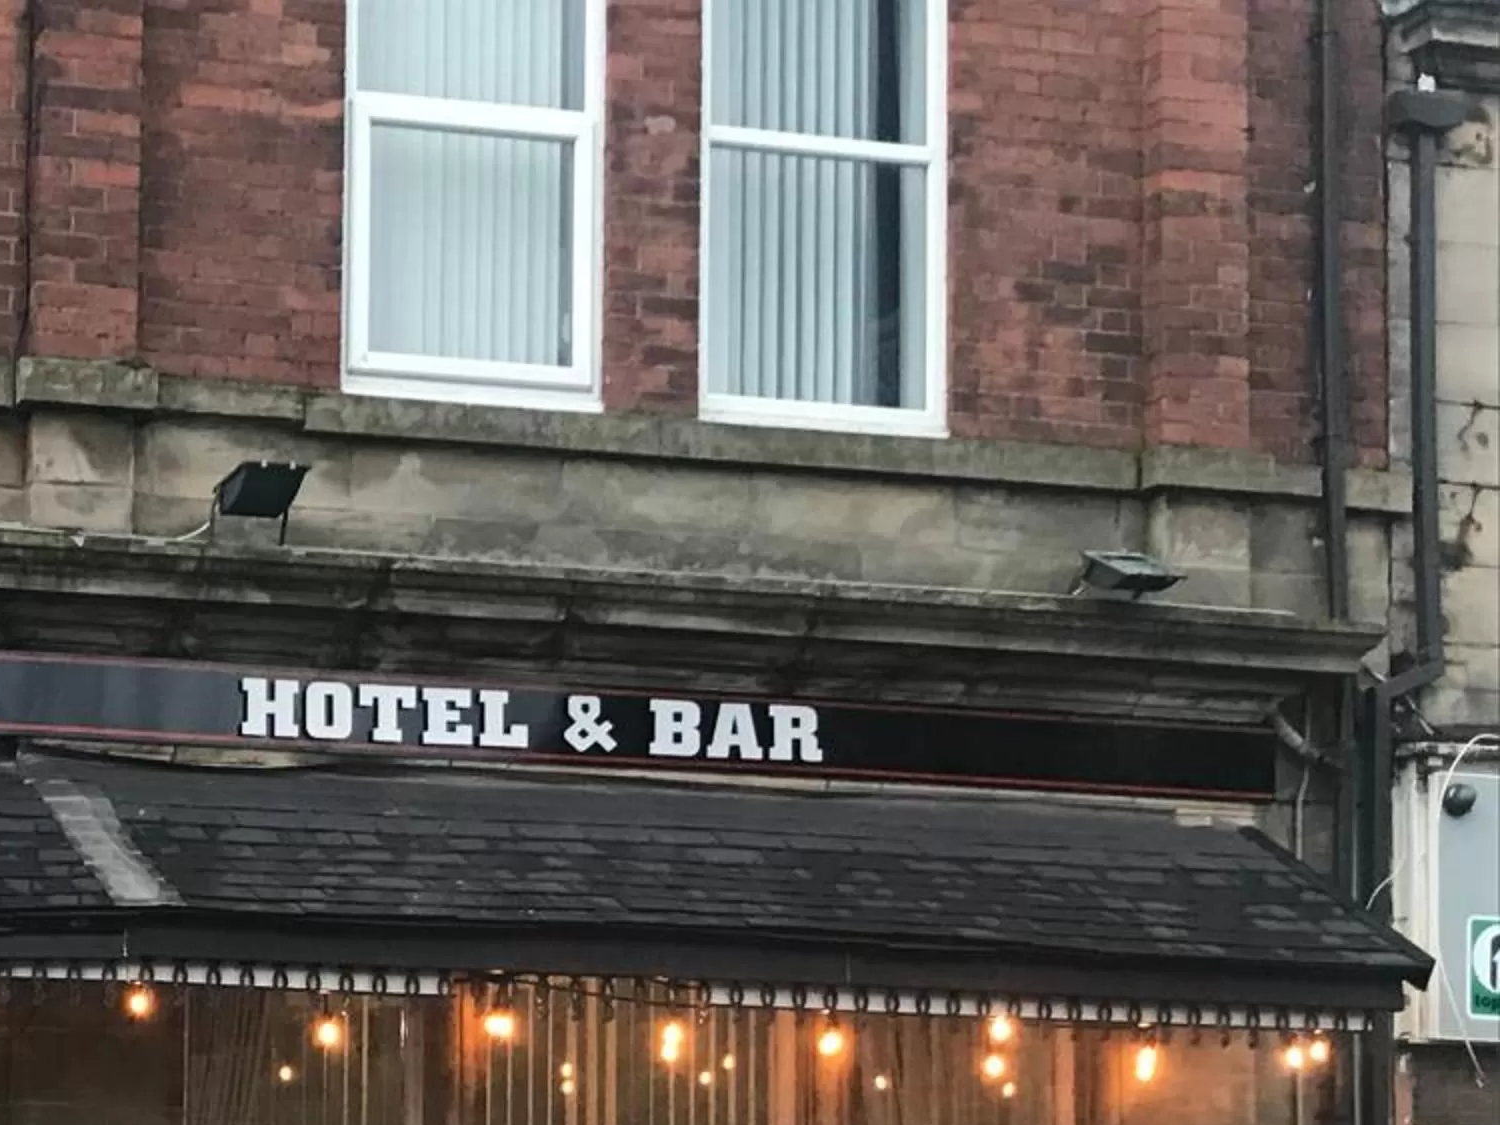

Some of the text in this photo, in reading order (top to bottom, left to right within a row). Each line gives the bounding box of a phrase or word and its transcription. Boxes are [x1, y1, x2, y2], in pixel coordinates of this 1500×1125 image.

[240, 677, 823, 763] HOTEL & BAR
